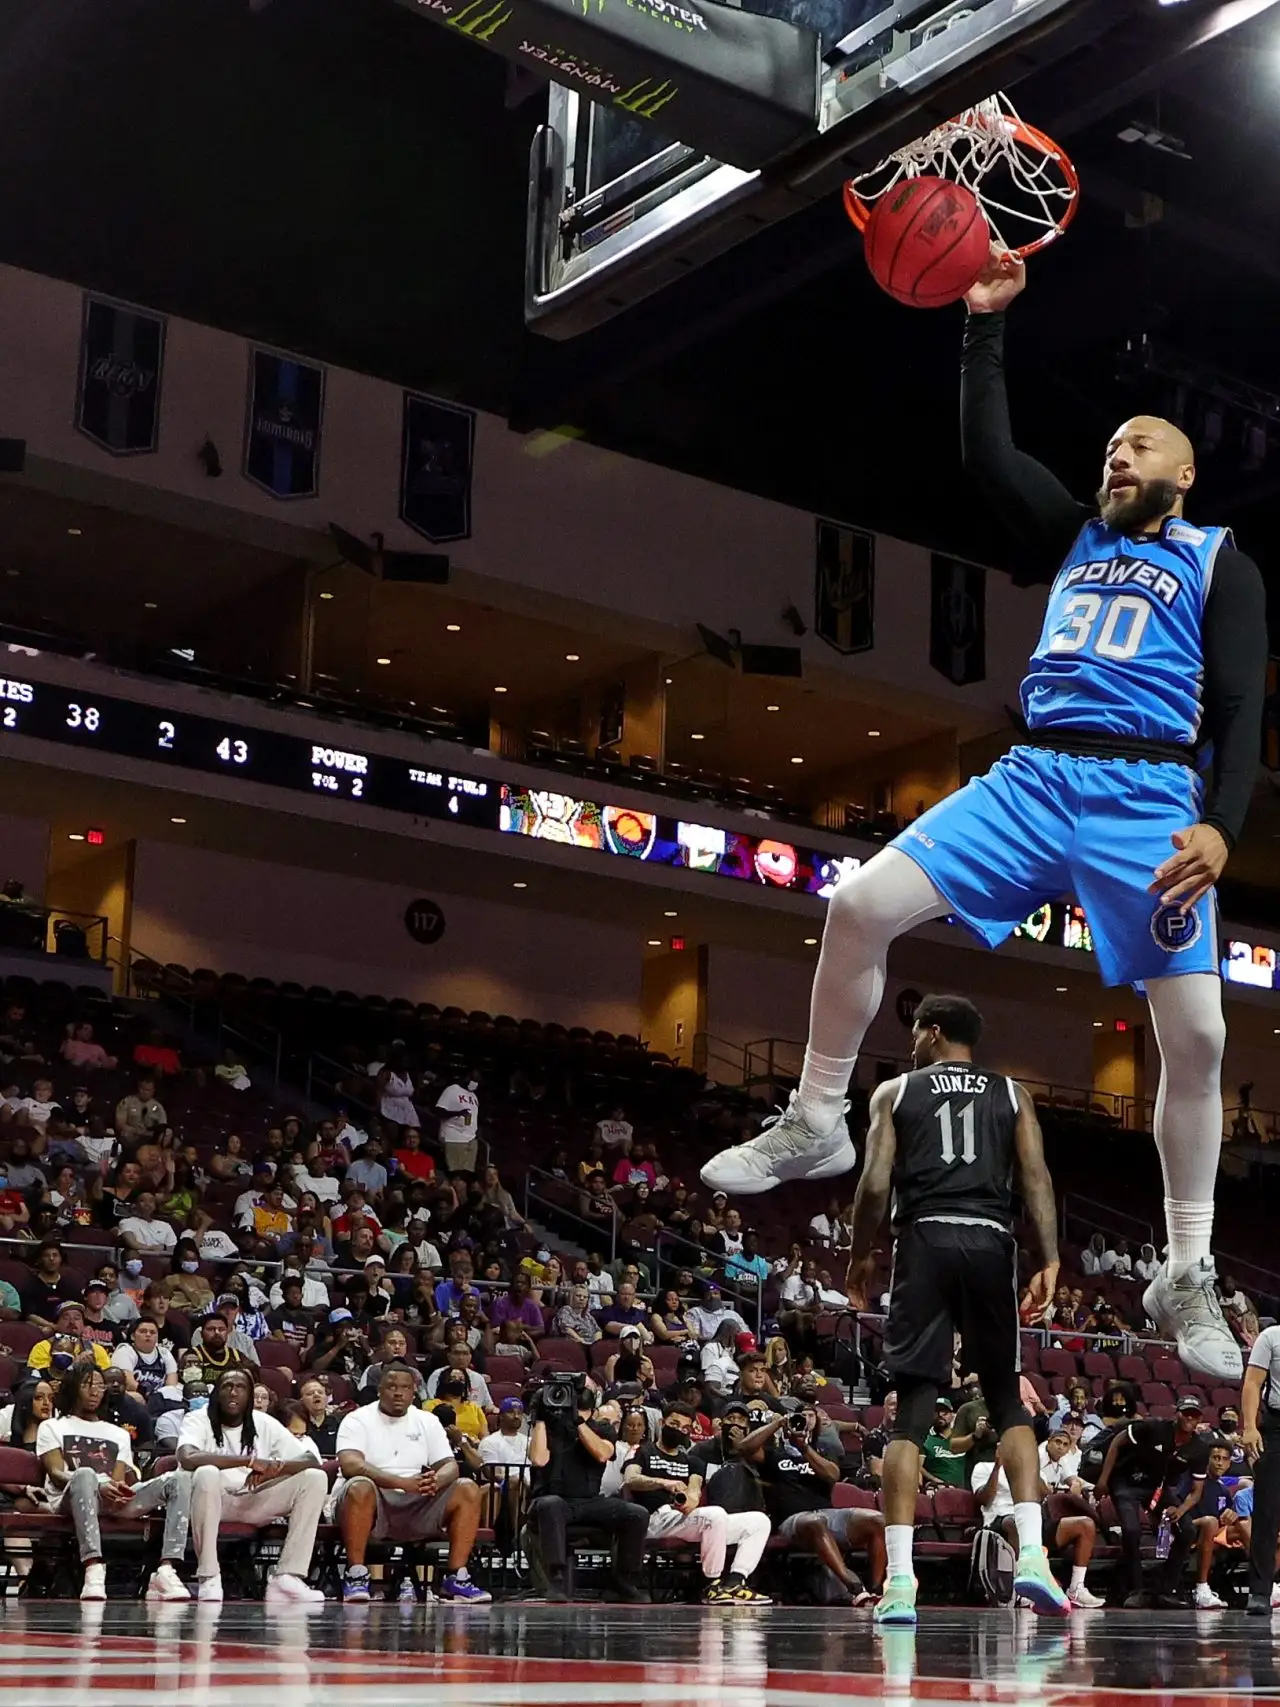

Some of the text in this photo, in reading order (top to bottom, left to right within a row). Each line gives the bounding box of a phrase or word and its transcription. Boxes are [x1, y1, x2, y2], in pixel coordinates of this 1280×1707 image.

[626, 0, 693, 32] ENERGY
[643, 0, 708, 30] STER
[1064, 558, 1181, 606] POWER
[1049, 593, 1153, 660] 30
[3, 707, 17, 727] 2
[66, 703, 100, 731] 38
[158, 721, 175, 748] 2
[216, 737, 248, 763] 43
[311, 746, 368, 774] POWER
[352, 778, 363, 796] 2
[448, 796, 458, 813] 4
[412, 911, 438, 931] 117
[930, 1074, 988, 1094] JONES
[934, 1100, 977, 1165] 11
